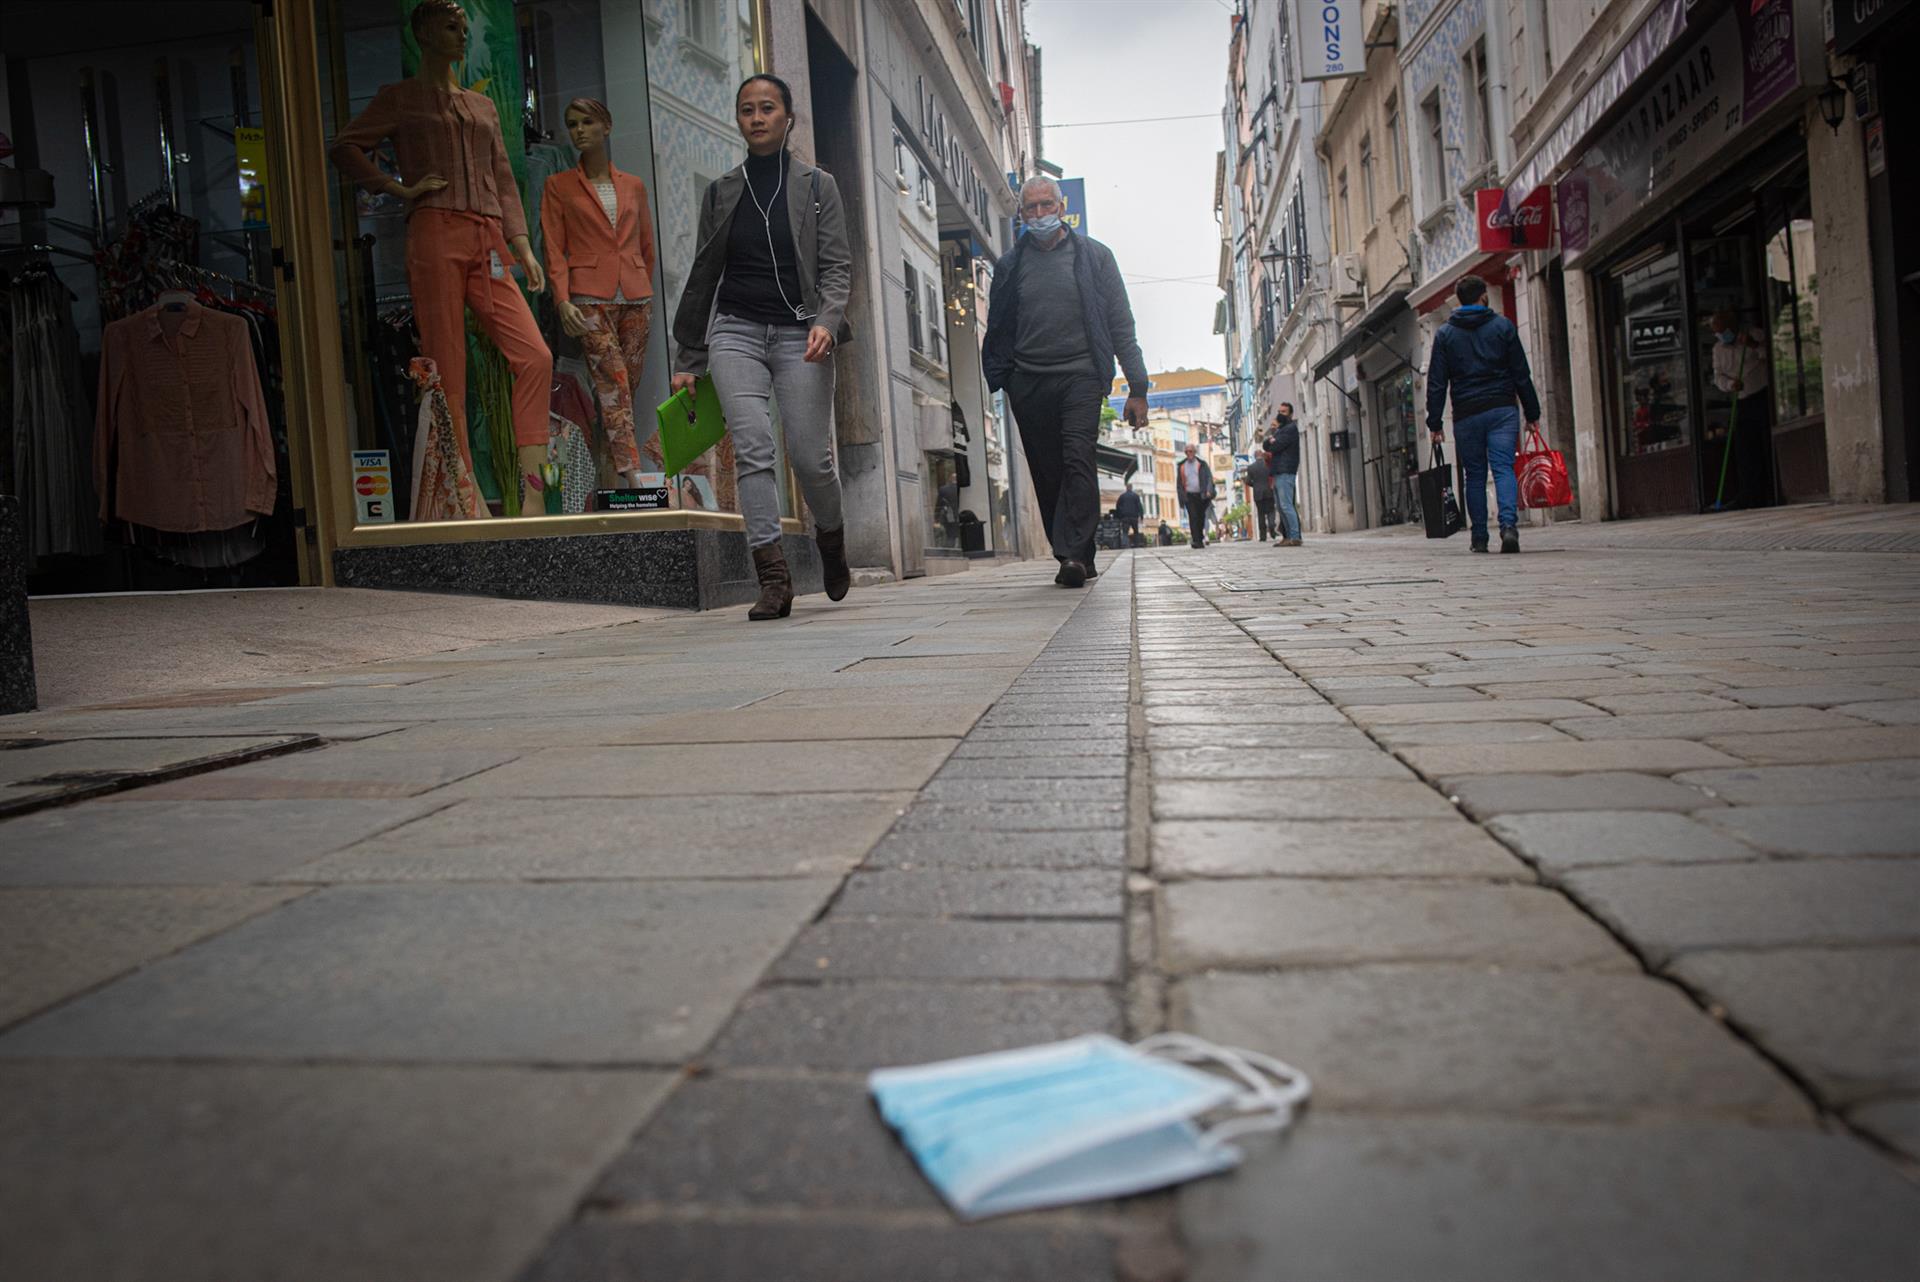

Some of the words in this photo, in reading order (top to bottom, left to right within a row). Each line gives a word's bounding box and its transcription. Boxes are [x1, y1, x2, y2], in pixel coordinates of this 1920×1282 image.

[1325, 63, 1344, 73] 280
[1638, 46, 1715, 138] BAZAAR
[360, 458, 382, 466] VISA
